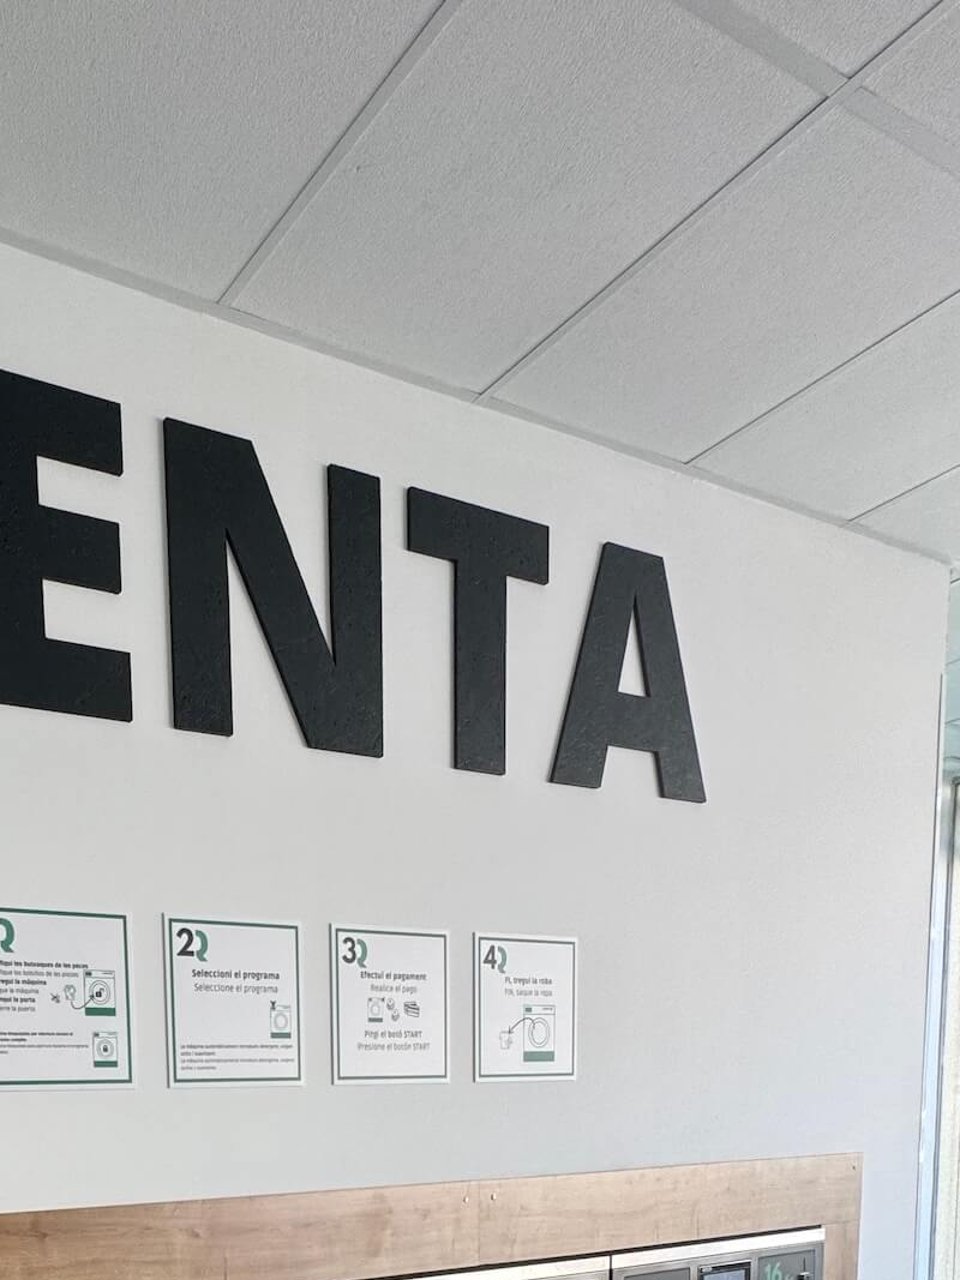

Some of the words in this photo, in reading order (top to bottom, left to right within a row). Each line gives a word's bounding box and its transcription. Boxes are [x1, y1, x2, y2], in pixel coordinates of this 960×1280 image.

[192, 969, 232, 979] Seleccioni
[234, 970, 240, 979] el
[243, 971, 280, 981] programa
[194, 983, 234, 992] Seleccione
[236, 984, 242, 992] el
[244, 985, 278, 994] programa
